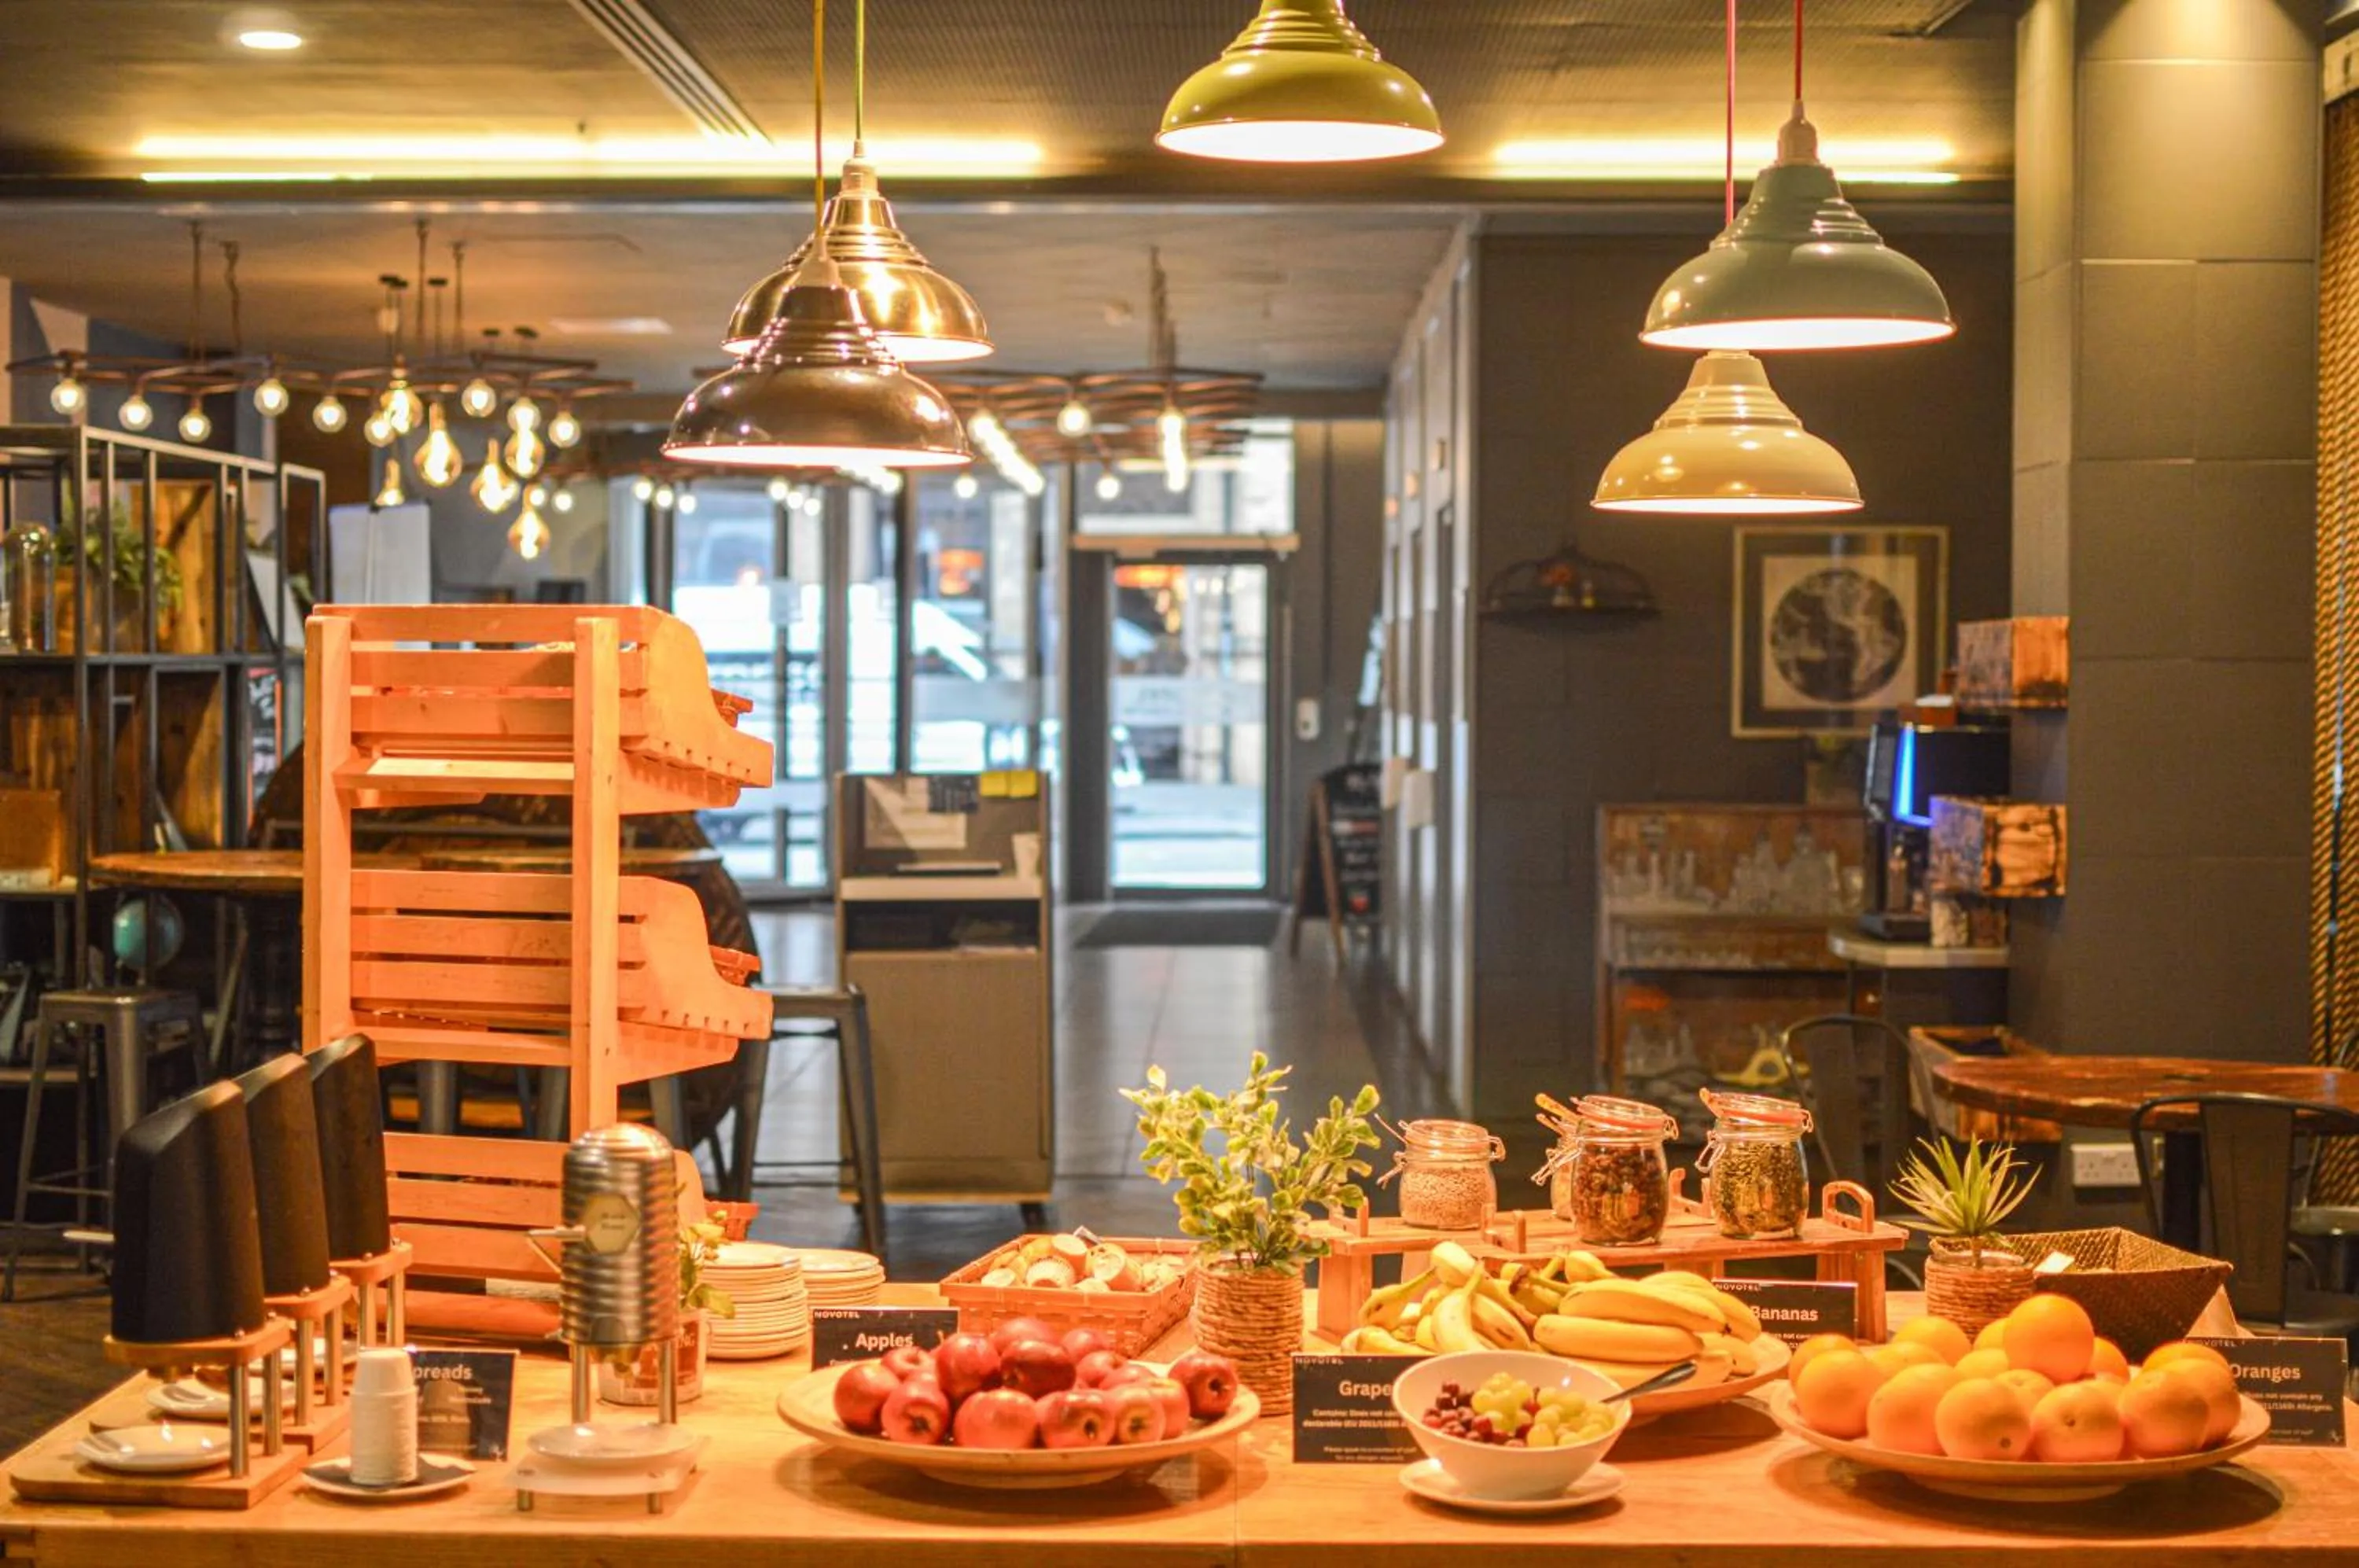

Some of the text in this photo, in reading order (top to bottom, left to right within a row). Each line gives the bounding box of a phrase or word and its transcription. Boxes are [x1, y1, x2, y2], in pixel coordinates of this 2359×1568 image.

[1750, 1305, 1819, 1322] Bananas
[855, 1331, 914, 1352] Apples
[413, 1363, 473, 1380] preads
[2229, 1363, 2302, 1383] Oranges
[1339, 1379, 1393, 1401] Grape
